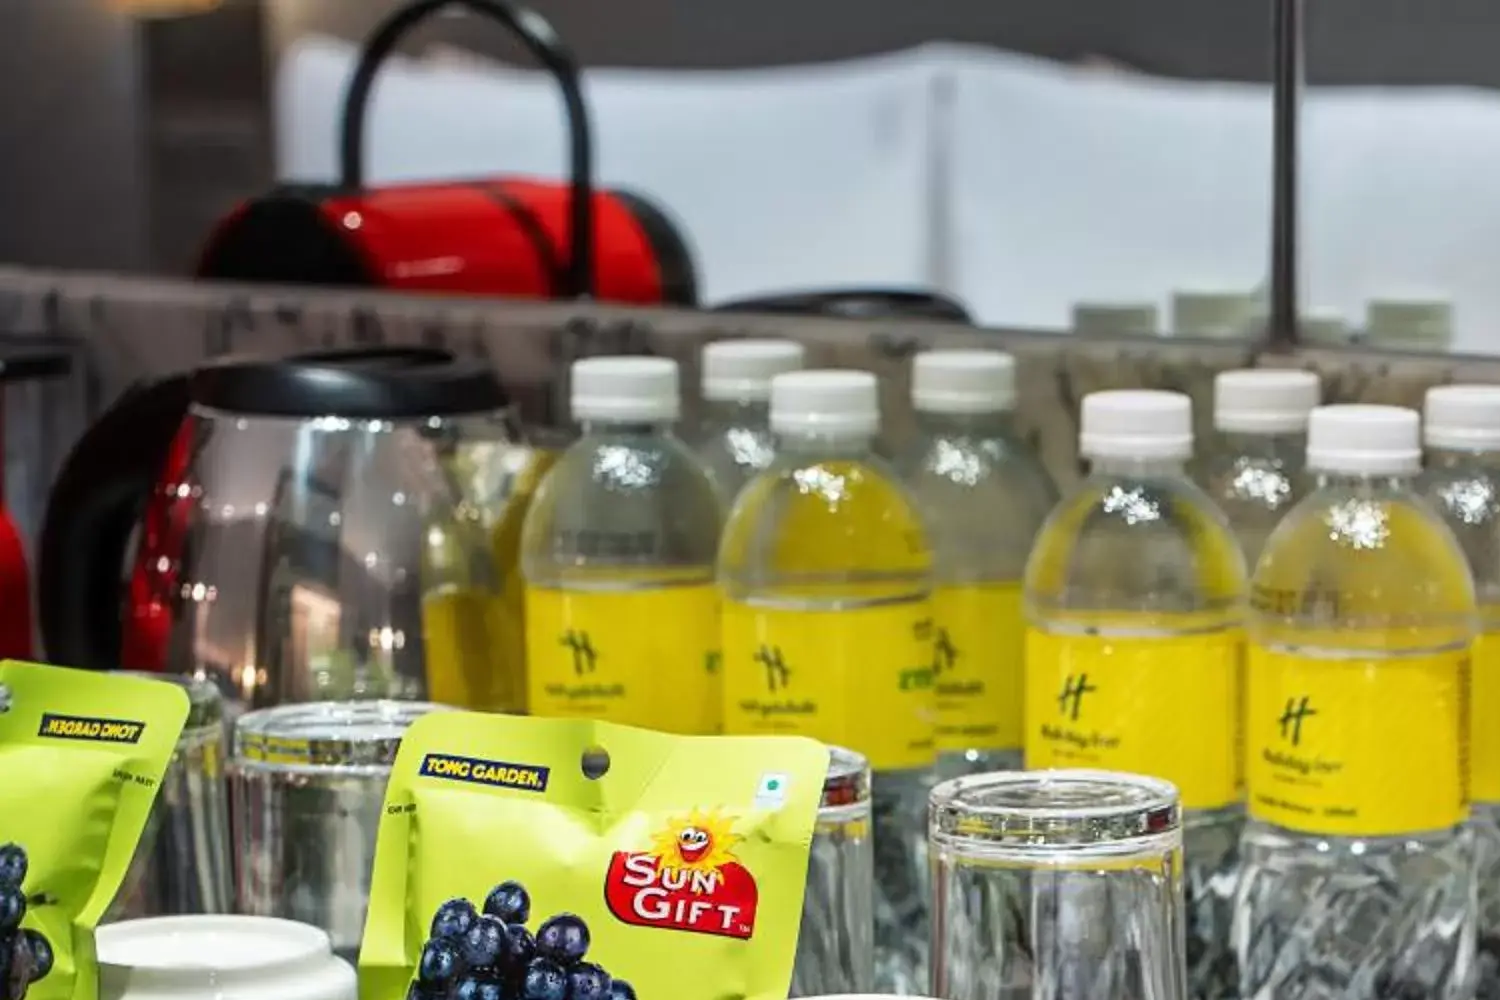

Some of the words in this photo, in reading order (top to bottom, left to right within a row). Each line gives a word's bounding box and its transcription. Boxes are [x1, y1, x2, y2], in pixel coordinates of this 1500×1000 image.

[1058, 673, 1097, 721] H
[1278, 696, 1318, 746] H
[427, 758, 470, 778] TONG
[472, 764, 540, 788] GARDEN
[623, 854, 718, 895] SUN
[633, 887, 741, 929] GIFT
